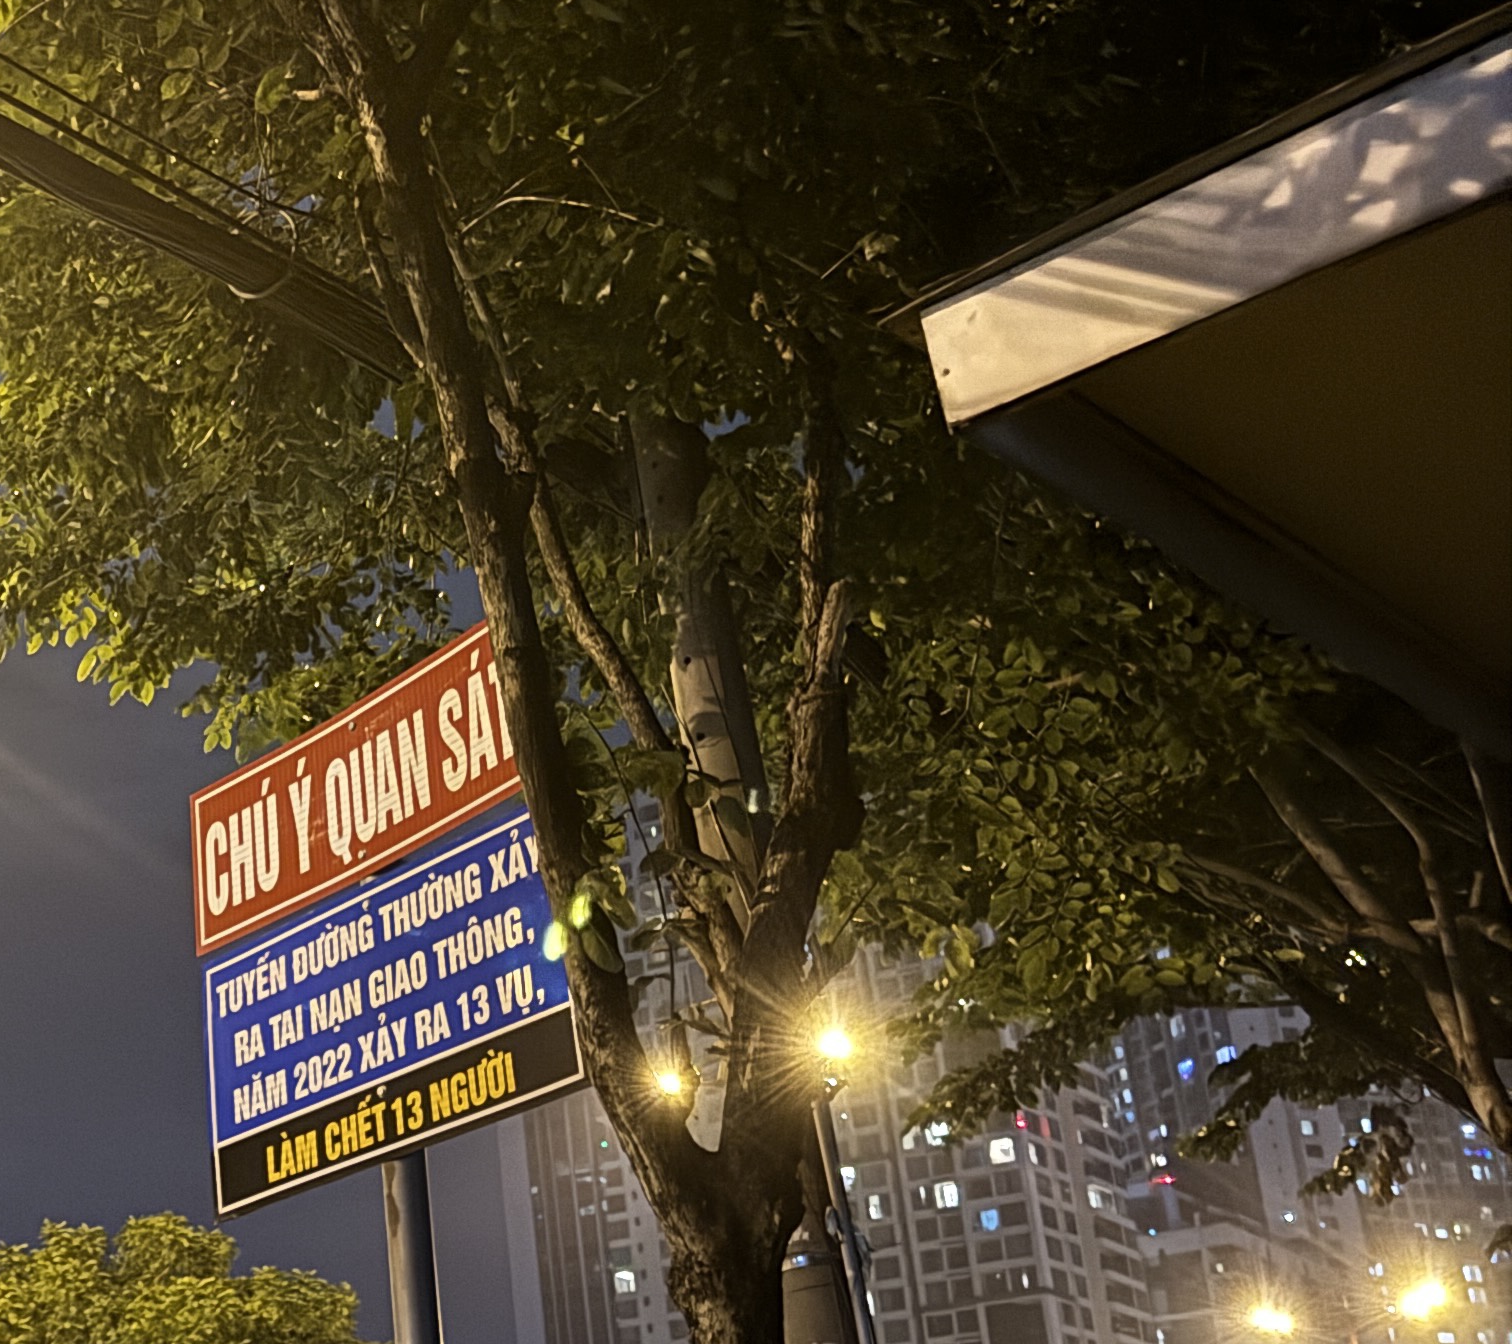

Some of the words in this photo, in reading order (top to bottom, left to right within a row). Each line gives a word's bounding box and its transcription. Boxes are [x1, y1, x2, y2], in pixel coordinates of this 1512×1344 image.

[205, 776, 280, 915] CHÚ
[288, 756, 311, 875] Ý
[325, 708, 431, 865] QUAN
[216, 950, 286, 1018] TUYẾN
[291, 915, 375, 985] ĐƯỜNG
[378, 862, 482, 941] THƯỜNG
[488, 828, 540, 895] XẢY
[233, 1024, 265, 1067] RA
[269, 1010, 303, 1051] TAI
[309, 979, 362, 1033] NẠN
[368, 951, 428, 1010] GIAO
[433, 906, 536, 981] THÔNG,
[233, 1068, 287, 1125] NĂM
[293, 1043, 353, 1101] 2022
[358, 1012, 406, 1073] XẢY
[414, 1002, 451, 1050] RA
[456, 984, 490, 1031] 13
[495, 965, 545, 1016] VỤ,
[266, 1131, 318, 1184] LÀM
[324, 1095, 387, 1161] CHẾT
[391, 1095, 423, 1136] 13
[429, 1050, 517, 1123] NGƯỜI
